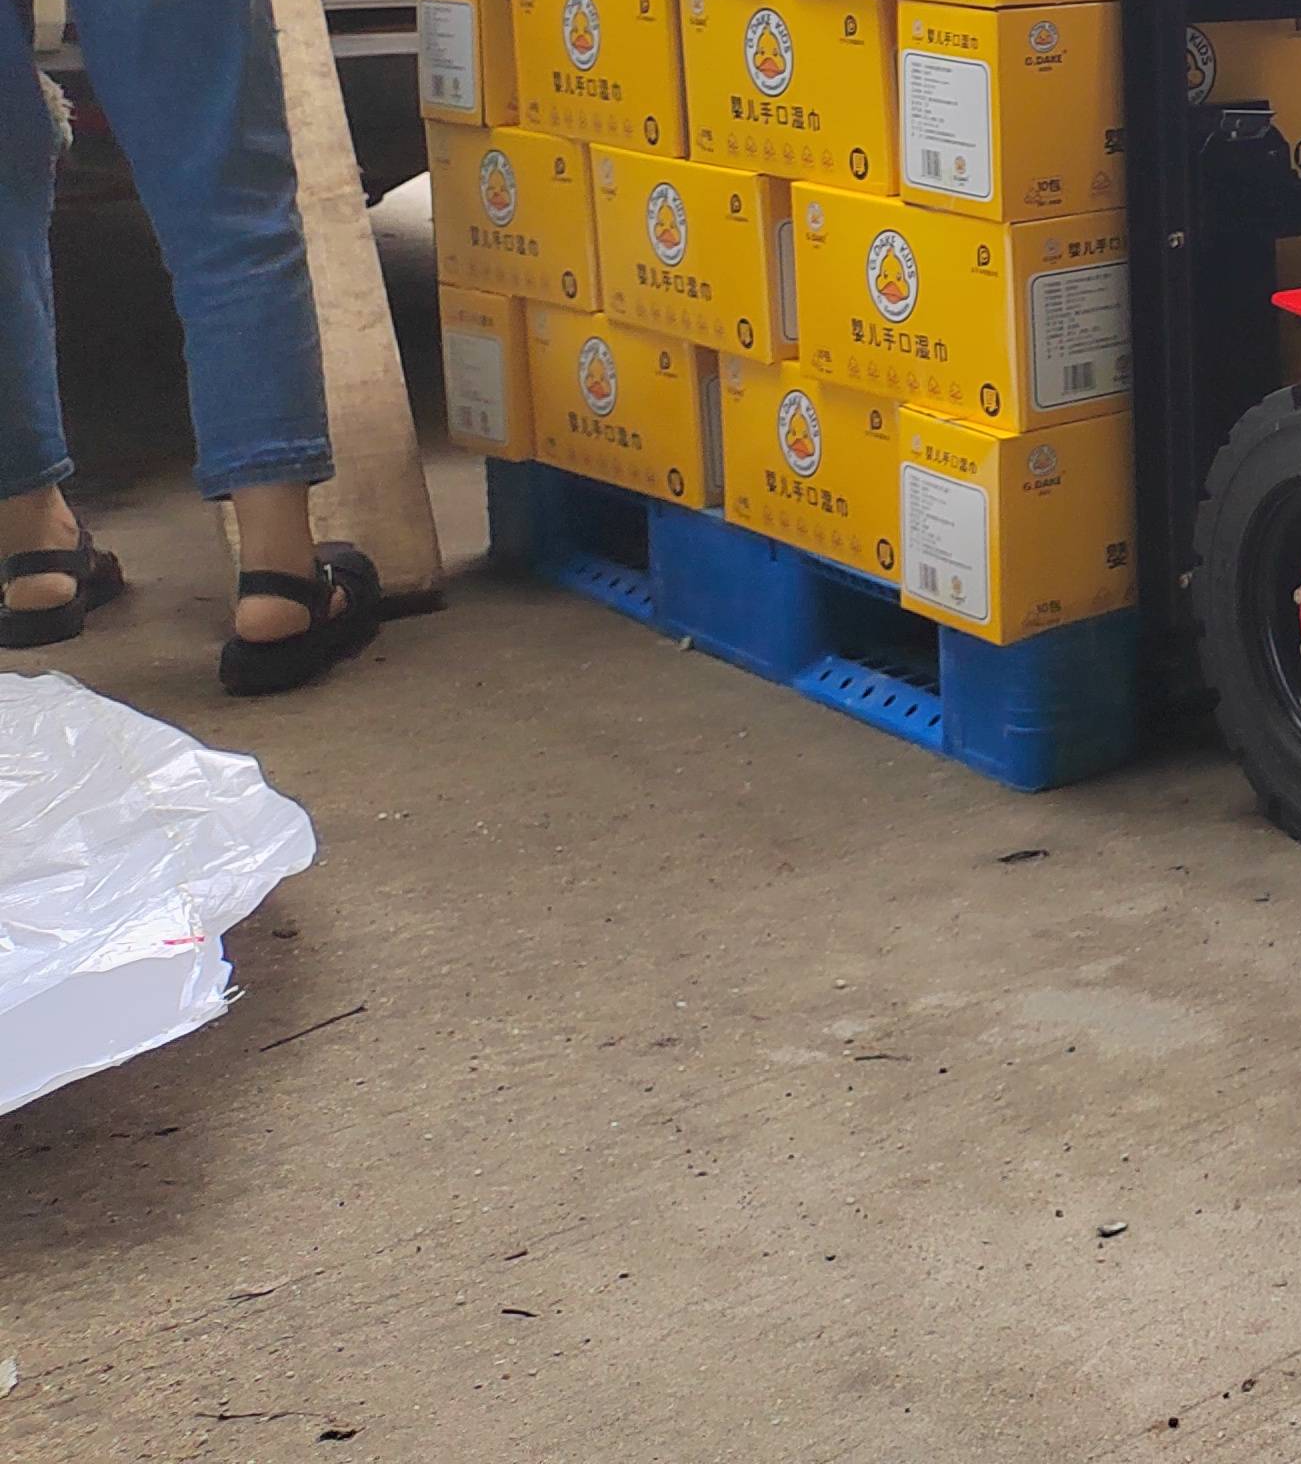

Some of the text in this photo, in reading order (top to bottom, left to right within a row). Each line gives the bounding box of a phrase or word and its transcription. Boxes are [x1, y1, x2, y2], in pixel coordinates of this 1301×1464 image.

[730, 96, 821, 131] 婴儿手口湿巾
[850, 319, 948, 362] 婴儿手口湿巾
[765, 470, 848, 518] 婴儿手口湿巾
